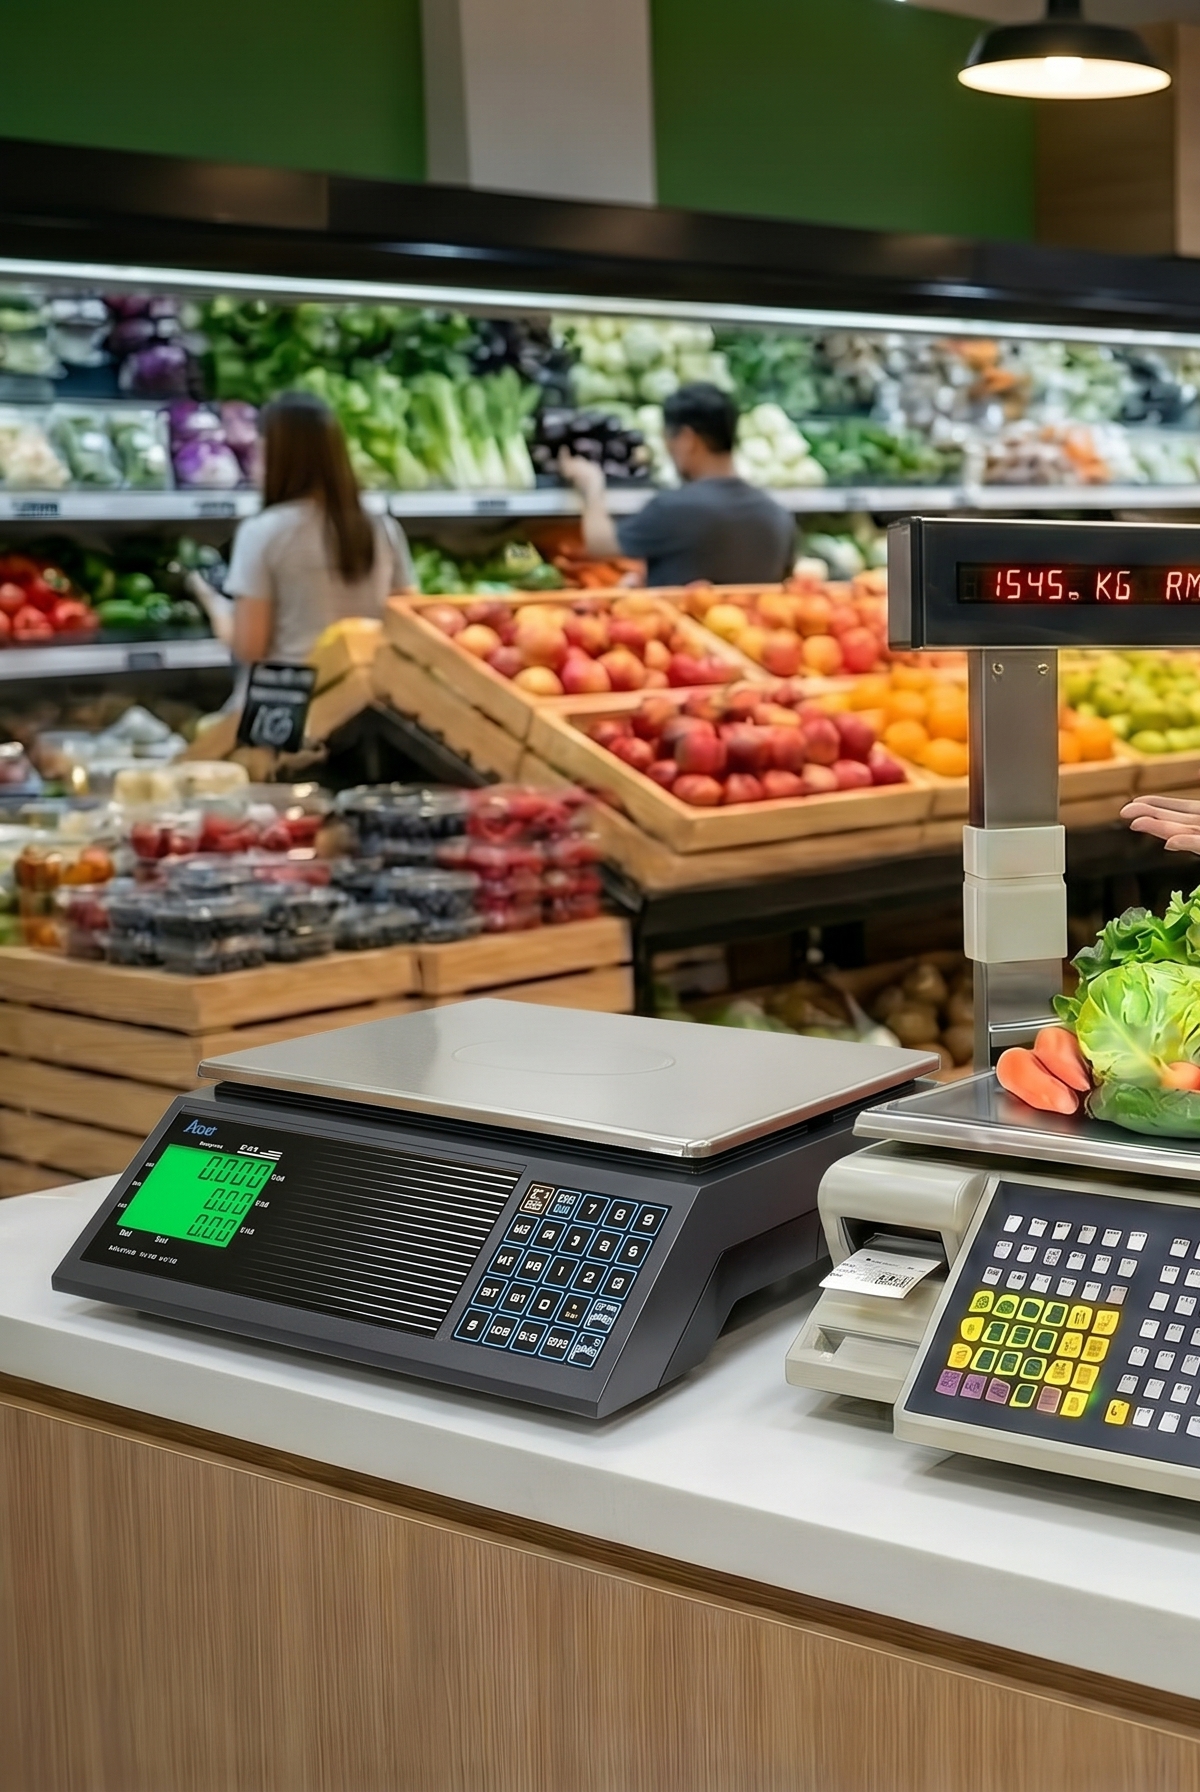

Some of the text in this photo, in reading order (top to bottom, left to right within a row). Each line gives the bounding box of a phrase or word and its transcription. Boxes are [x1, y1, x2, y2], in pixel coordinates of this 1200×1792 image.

[1096, 571, 1130, 600] KG
[613, 1209, 626, 1221] 8
[583, 1271, 595, 1284] 2
